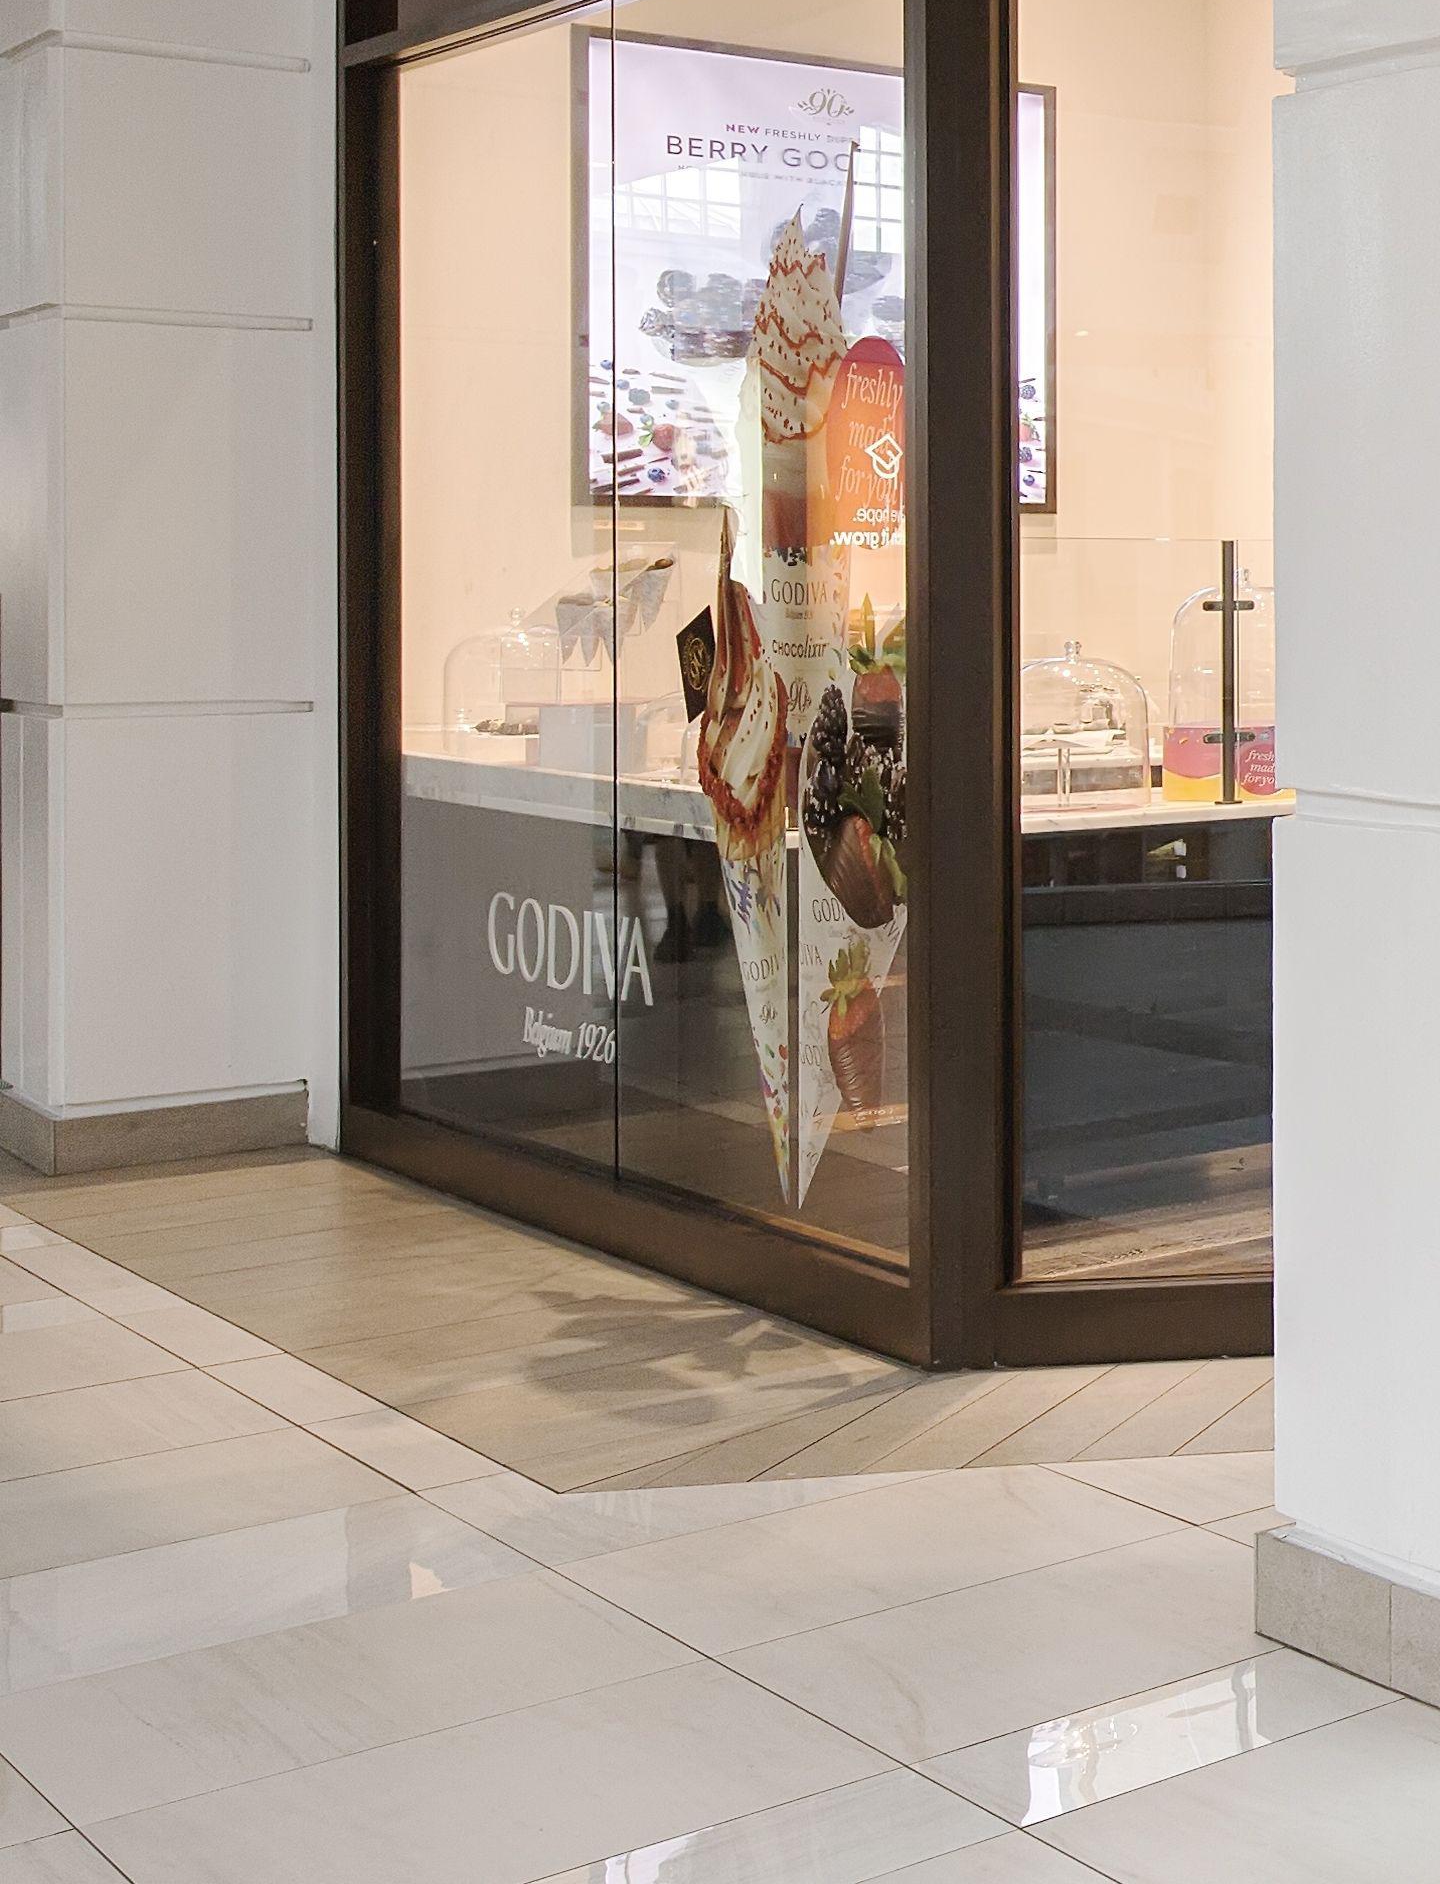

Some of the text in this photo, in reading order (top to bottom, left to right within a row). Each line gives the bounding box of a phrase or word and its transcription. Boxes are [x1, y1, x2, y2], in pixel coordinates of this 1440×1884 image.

[666, 135, 769, 164] BERRY
[725, 123, 761, 134] NEW
[764, 128, 822, 141] FRESHLY
[841, 362, 904, 420] freshly
[771, 578, 828, 606] GODIVA
[488, 891, 654, 1006] GODIVA
[522, 1006, 616, 1064] Belgium 1926
